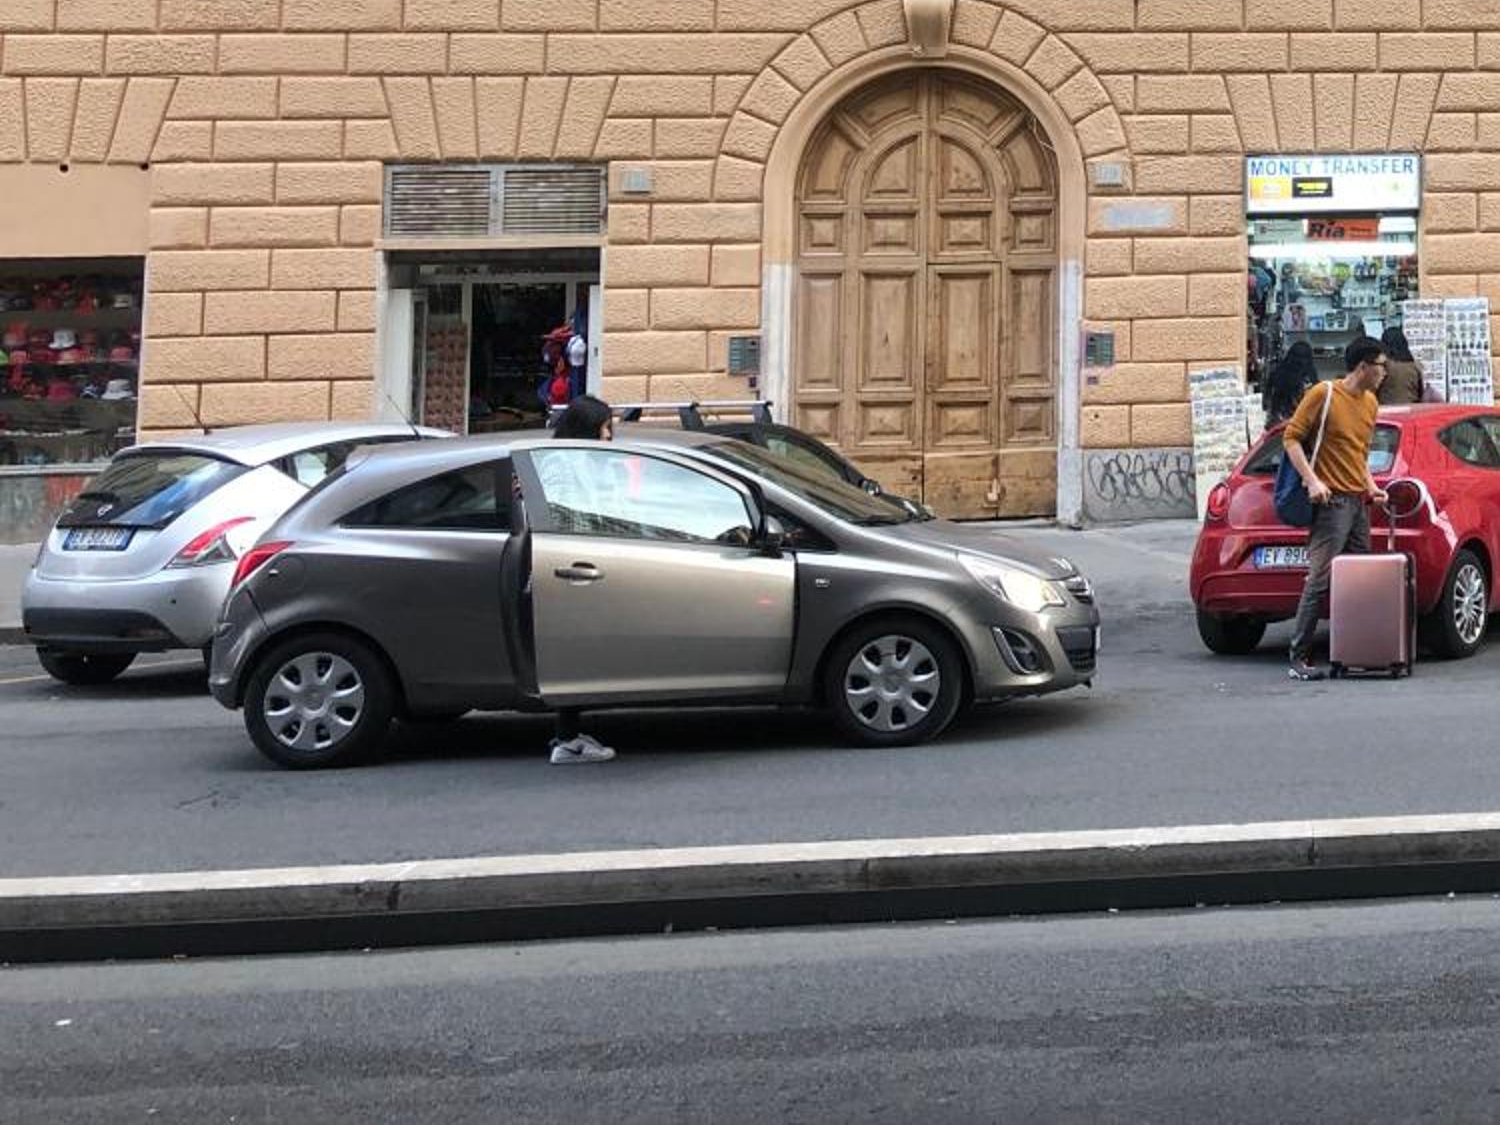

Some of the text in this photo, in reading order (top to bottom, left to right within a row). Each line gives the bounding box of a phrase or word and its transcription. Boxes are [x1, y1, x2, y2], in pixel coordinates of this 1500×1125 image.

[1251, 159, 1413, 175] MONEY TRANSFER
[1308, 220, 1345, 238] Ria
